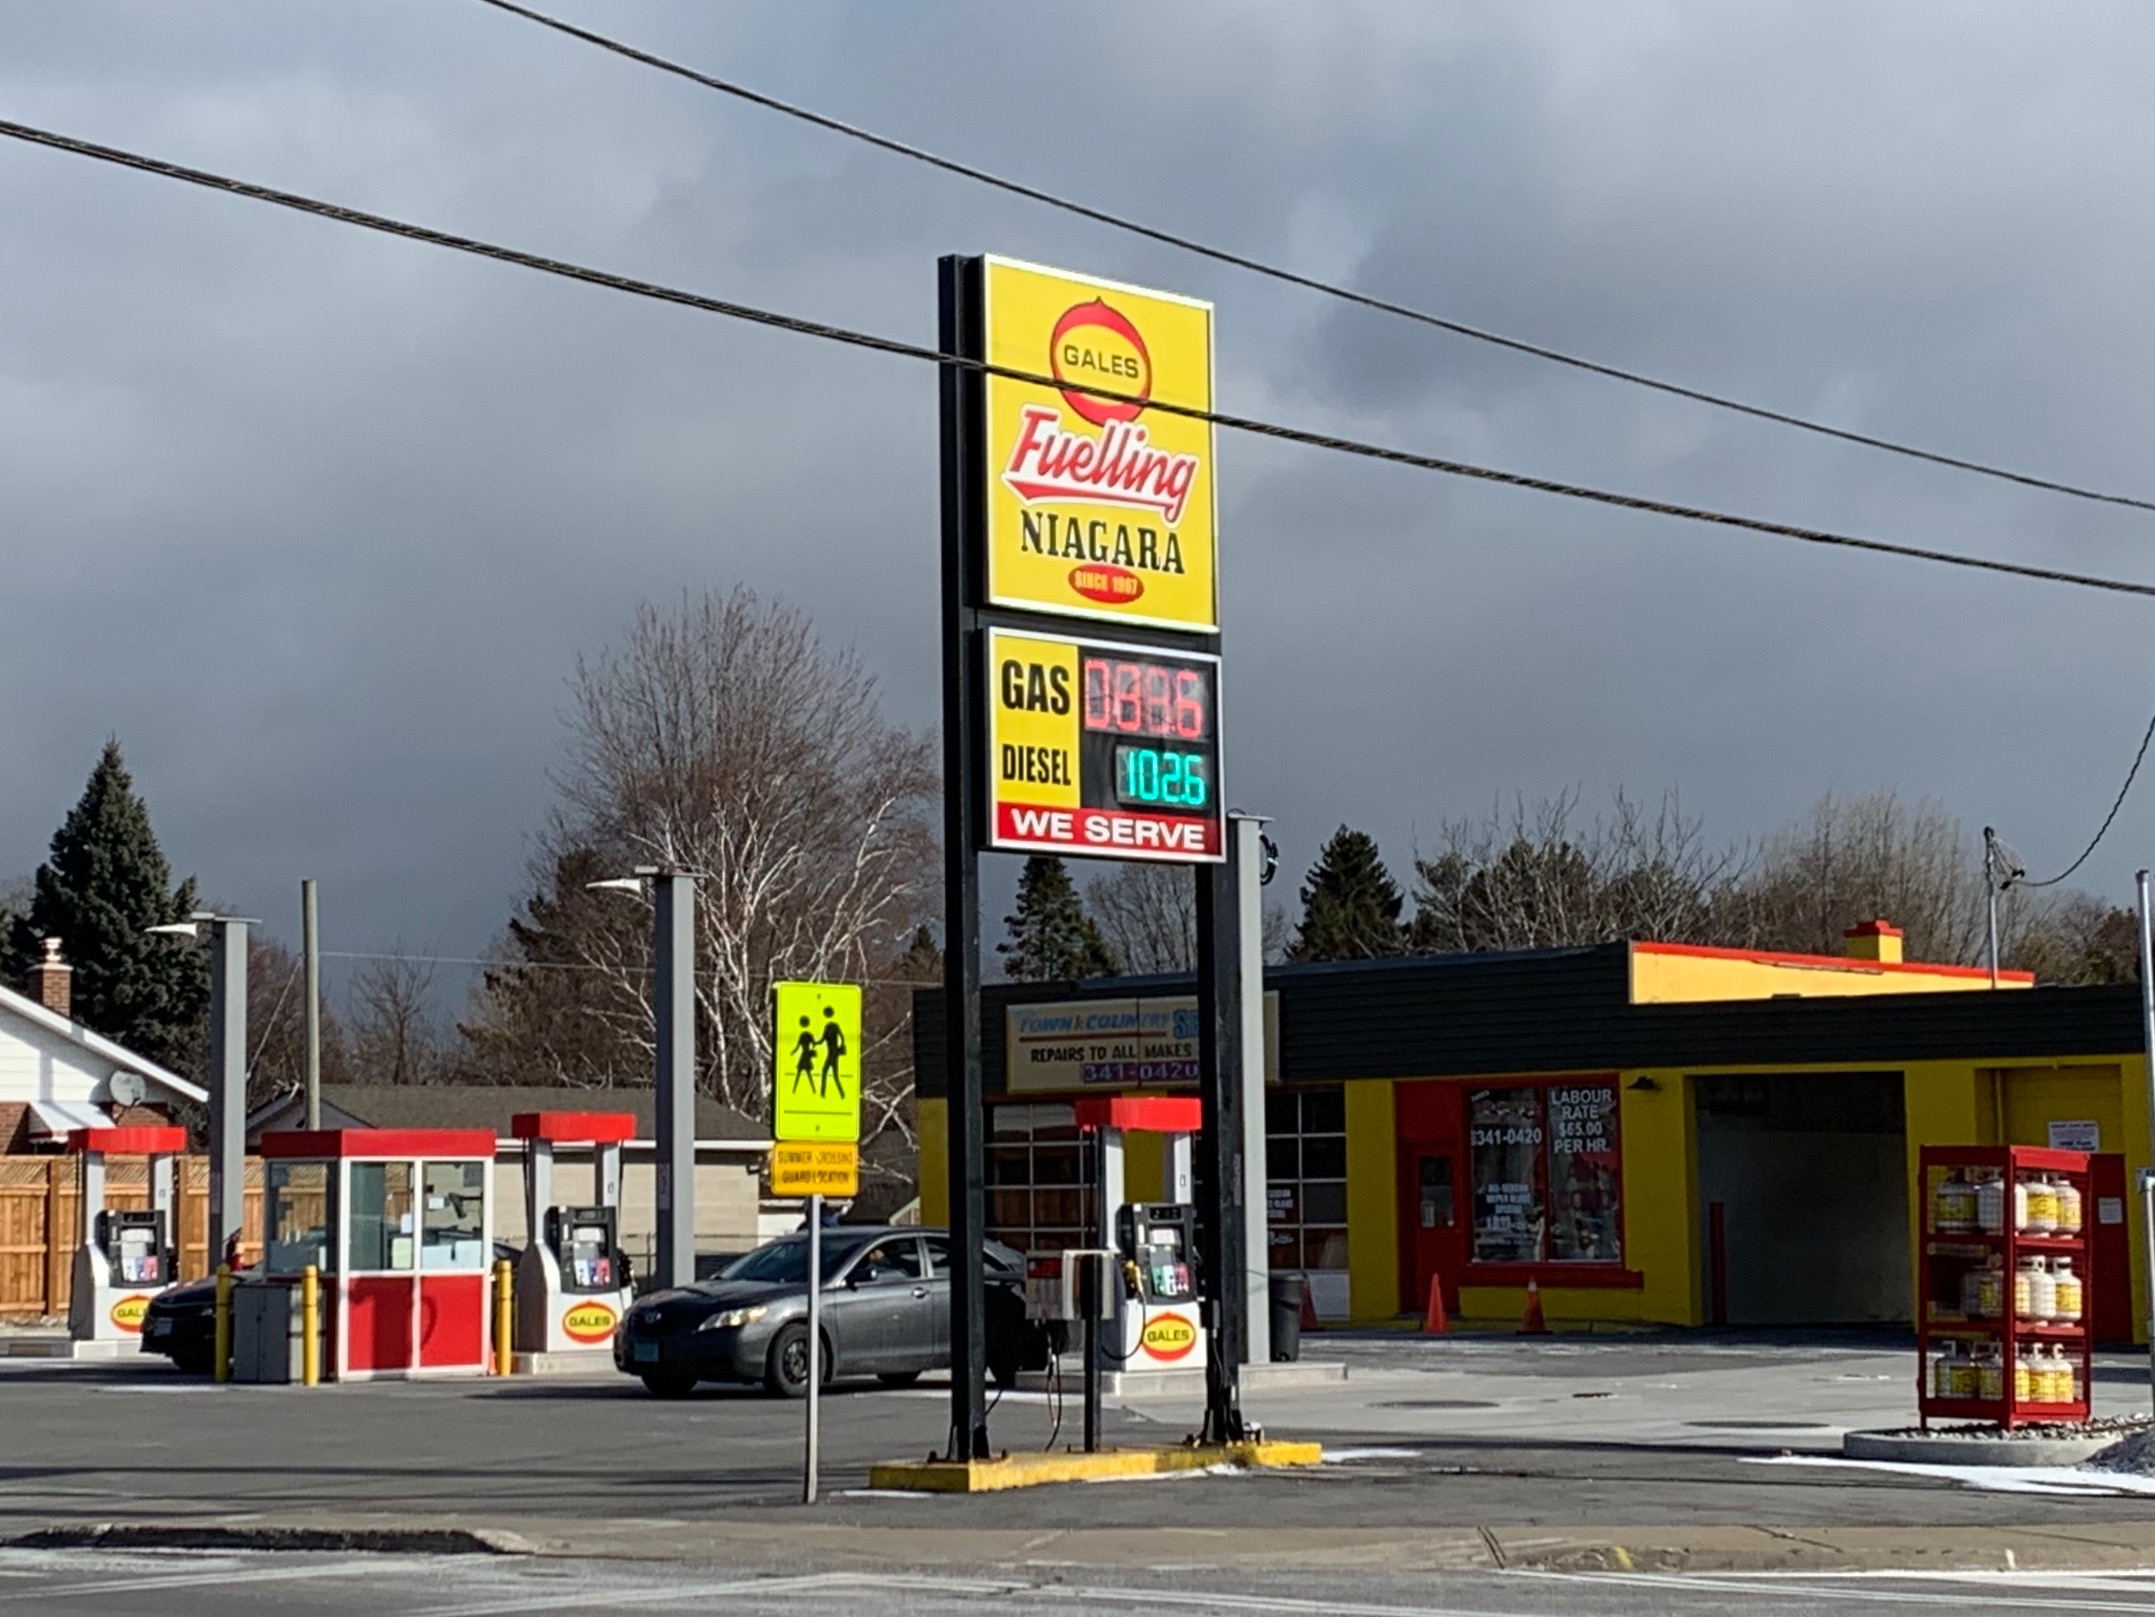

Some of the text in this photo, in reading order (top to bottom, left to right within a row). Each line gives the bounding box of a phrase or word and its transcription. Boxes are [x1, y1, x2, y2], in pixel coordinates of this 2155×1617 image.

[1063, 344, 1139, 379] GALES
[1007, 406, 1198, 525] Fuelling
[1020, 510, 1185, 574] NIAGARA
[1001, 659, 1071, 715] GAS
[1002, 743, 1072, 786] DIESEL
[1011, 808, 1205, 850] WE SERVE
[1031, 1043, 1192, 1062] REPAIRS TO ALL MAKES
[1551, 1089, 1612, 1105] LABOUR
[1562, 1105, 1599, 1119] RATE
[1554, 1139, 1583, 1153] PER
[569, 1316, 611, 1327] GALES
[1147, 1329, 1190, 1342] GALES
